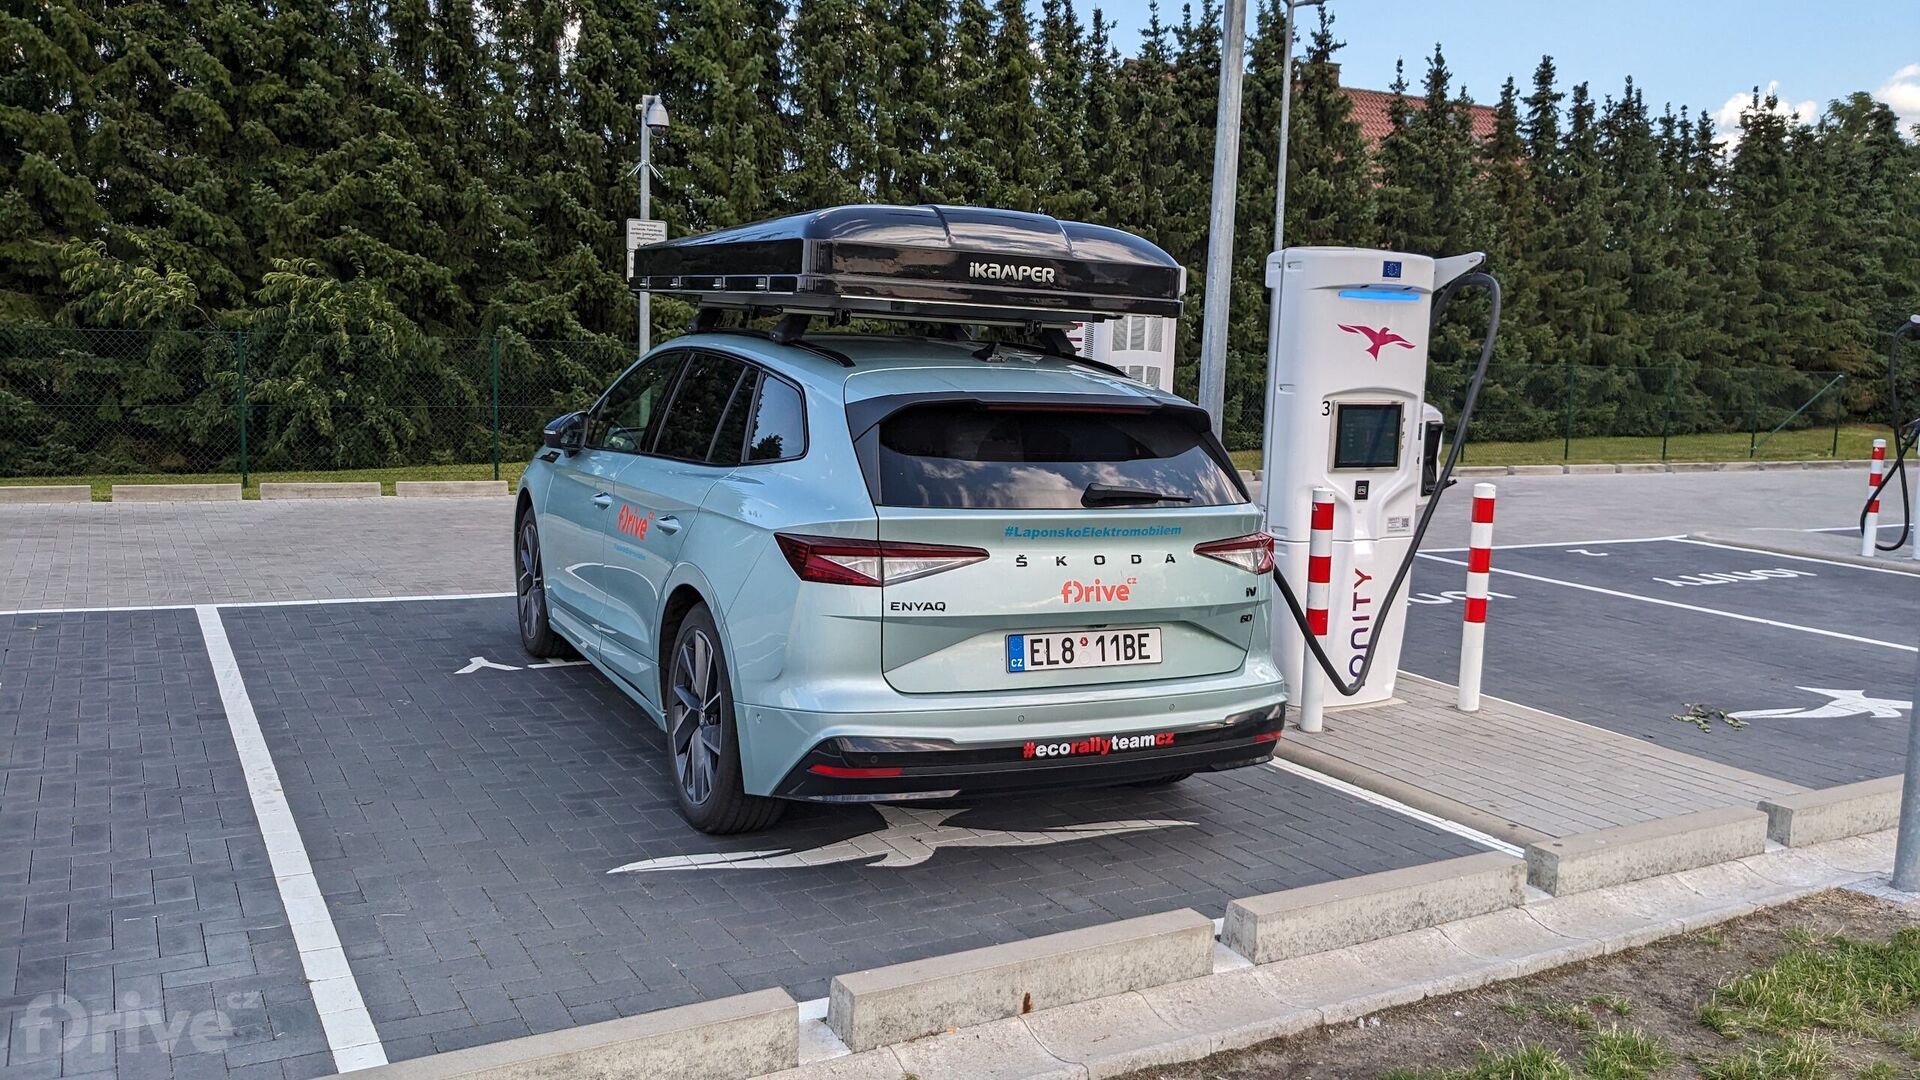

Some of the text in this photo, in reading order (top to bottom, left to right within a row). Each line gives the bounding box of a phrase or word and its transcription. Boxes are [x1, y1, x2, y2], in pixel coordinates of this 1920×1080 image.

[1321, 401, 1331, 416] 3
[1004, 525, 1181, 540] #LaponskoElektromobilem
[1015, 553, 1177, 567] ŠKODA
[890, 601, 946, 612] ENYAQ
[1239, 614, 1253, 624] 60
[1011, 632, 1150, 668] CZ EL8 11BE
[1023, 732, 1174, 758] #ecorallyteamcz
